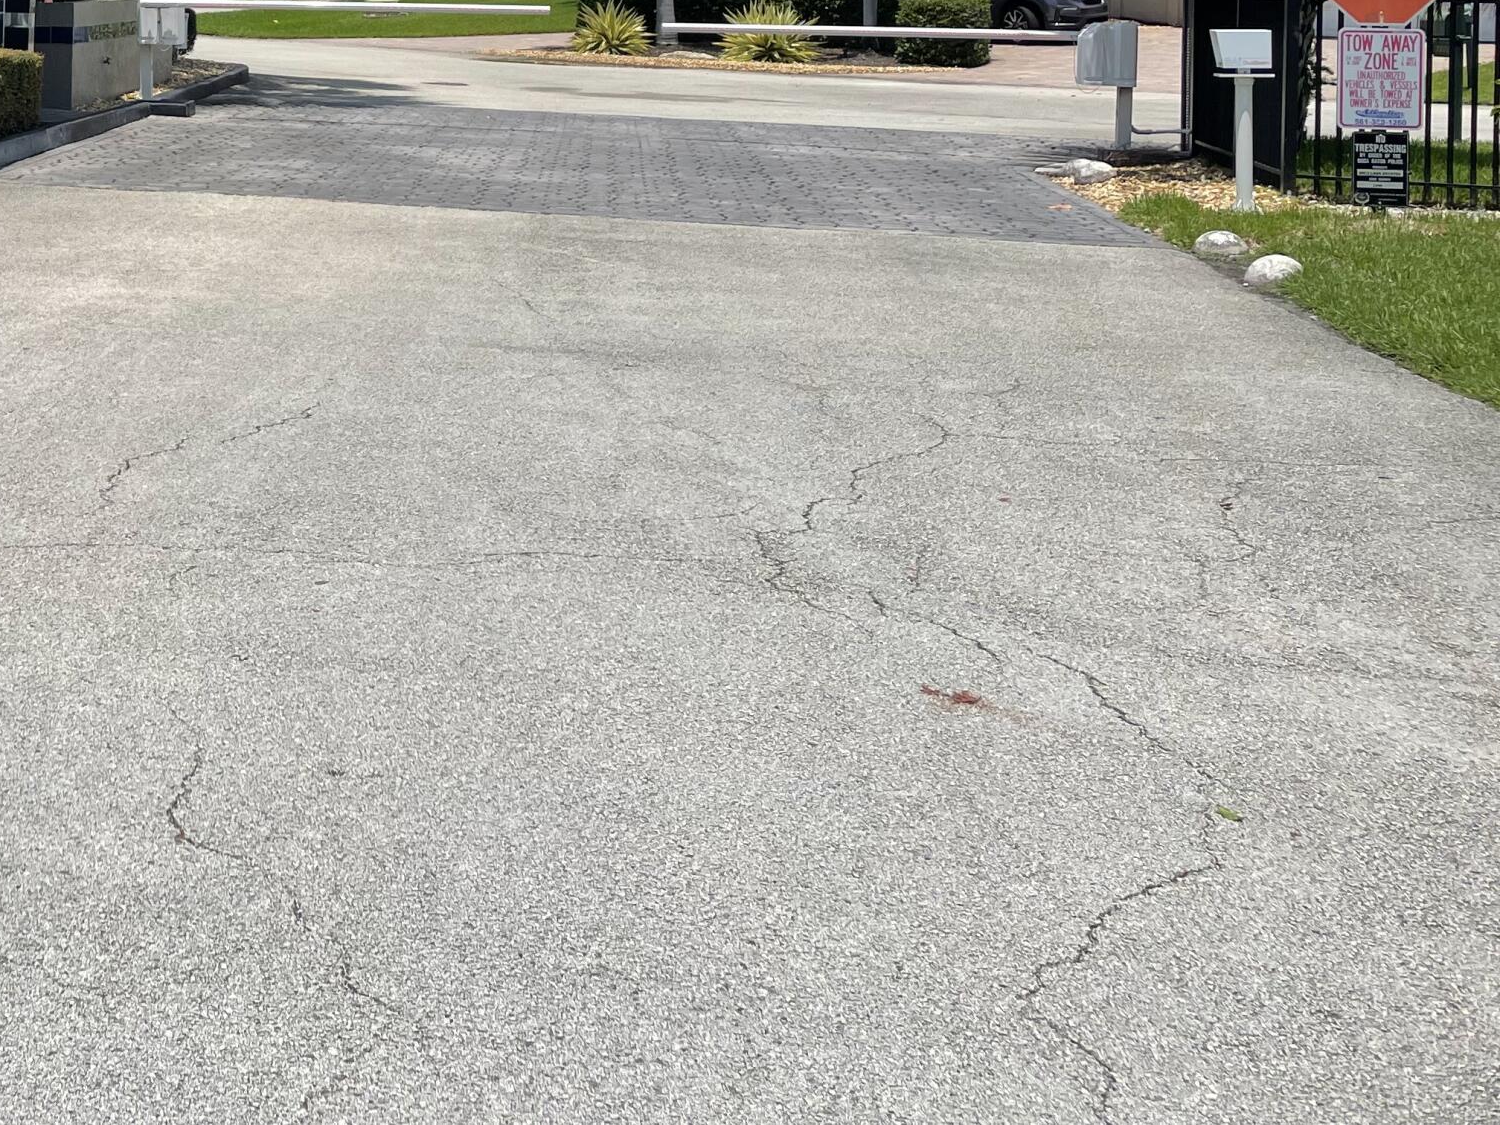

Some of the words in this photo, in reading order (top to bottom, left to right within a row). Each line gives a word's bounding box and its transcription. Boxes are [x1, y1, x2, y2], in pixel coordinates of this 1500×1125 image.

[1346, 35, 1373, 51] TOW
[1381, 35, 1418, 52] AWAY
[1364, 52, 1399, 70] ZONE
[1357, 71, 1406, 81] UNAUTHORIZED
[1345, 80, 1375, 89] VEHICLES
[1379, 81, 1386, 90] &
[1390, 81, 1418, 90] VESSELS
[1349, 90, 1364, 99] WILL
[1368, 90, 1376, 99] BE
[1381, 90, 1402, 100] TOWED
[1406, 91, 1413, 101] AT
[1349, 99, 1379, 108] OWNER'S
[1383, 99, 1412, 109] EXPENSE
[1355, 144, 1406, 153] TRESPASSING
